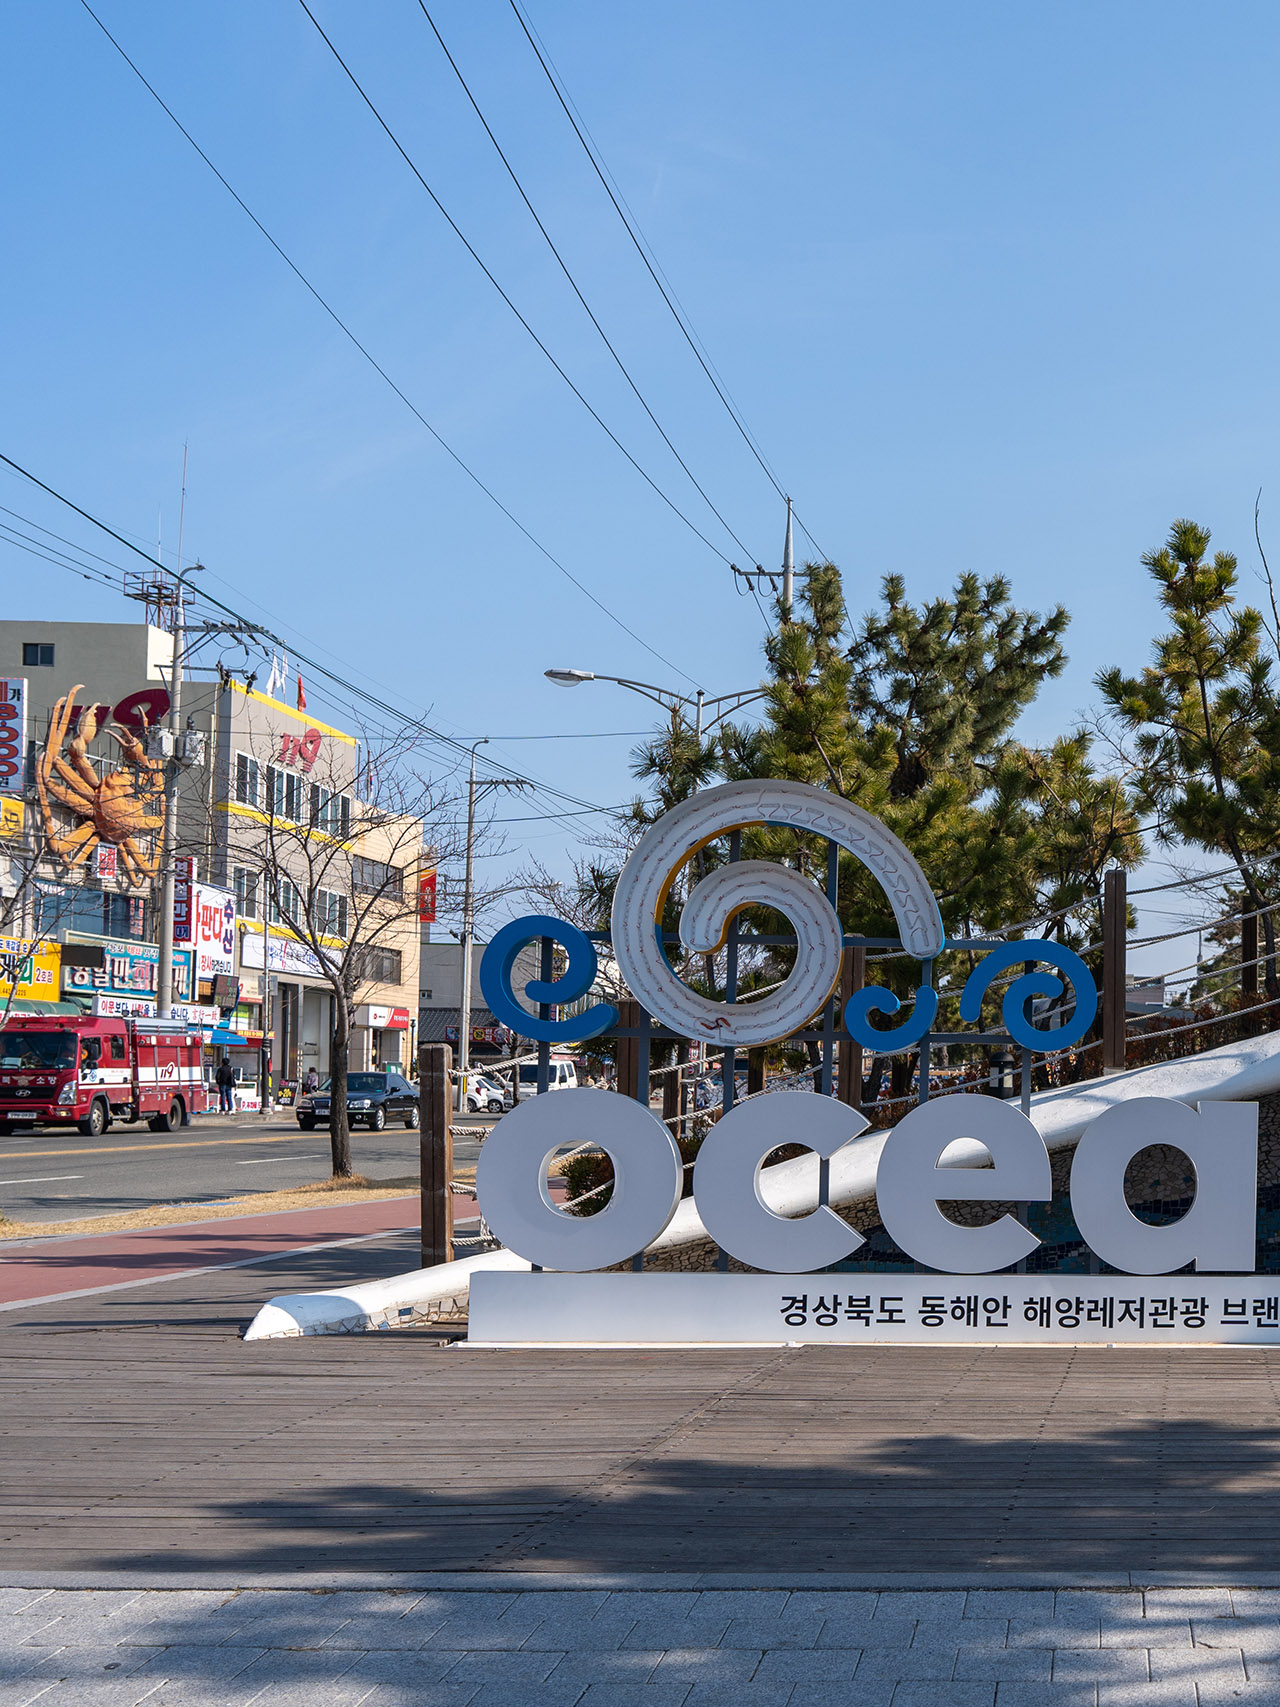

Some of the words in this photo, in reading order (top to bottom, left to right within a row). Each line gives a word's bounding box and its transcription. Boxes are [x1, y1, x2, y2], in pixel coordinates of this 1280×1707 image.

[276, 728, 322, 774] 119
[160, 1062, 175, 1079] 119
[780, 1294, 906, 1328] 경상북도
[917, 1295, 1012, 1328] 동해안
[1023, 1296, 1209, 1329] 해양레저관광
